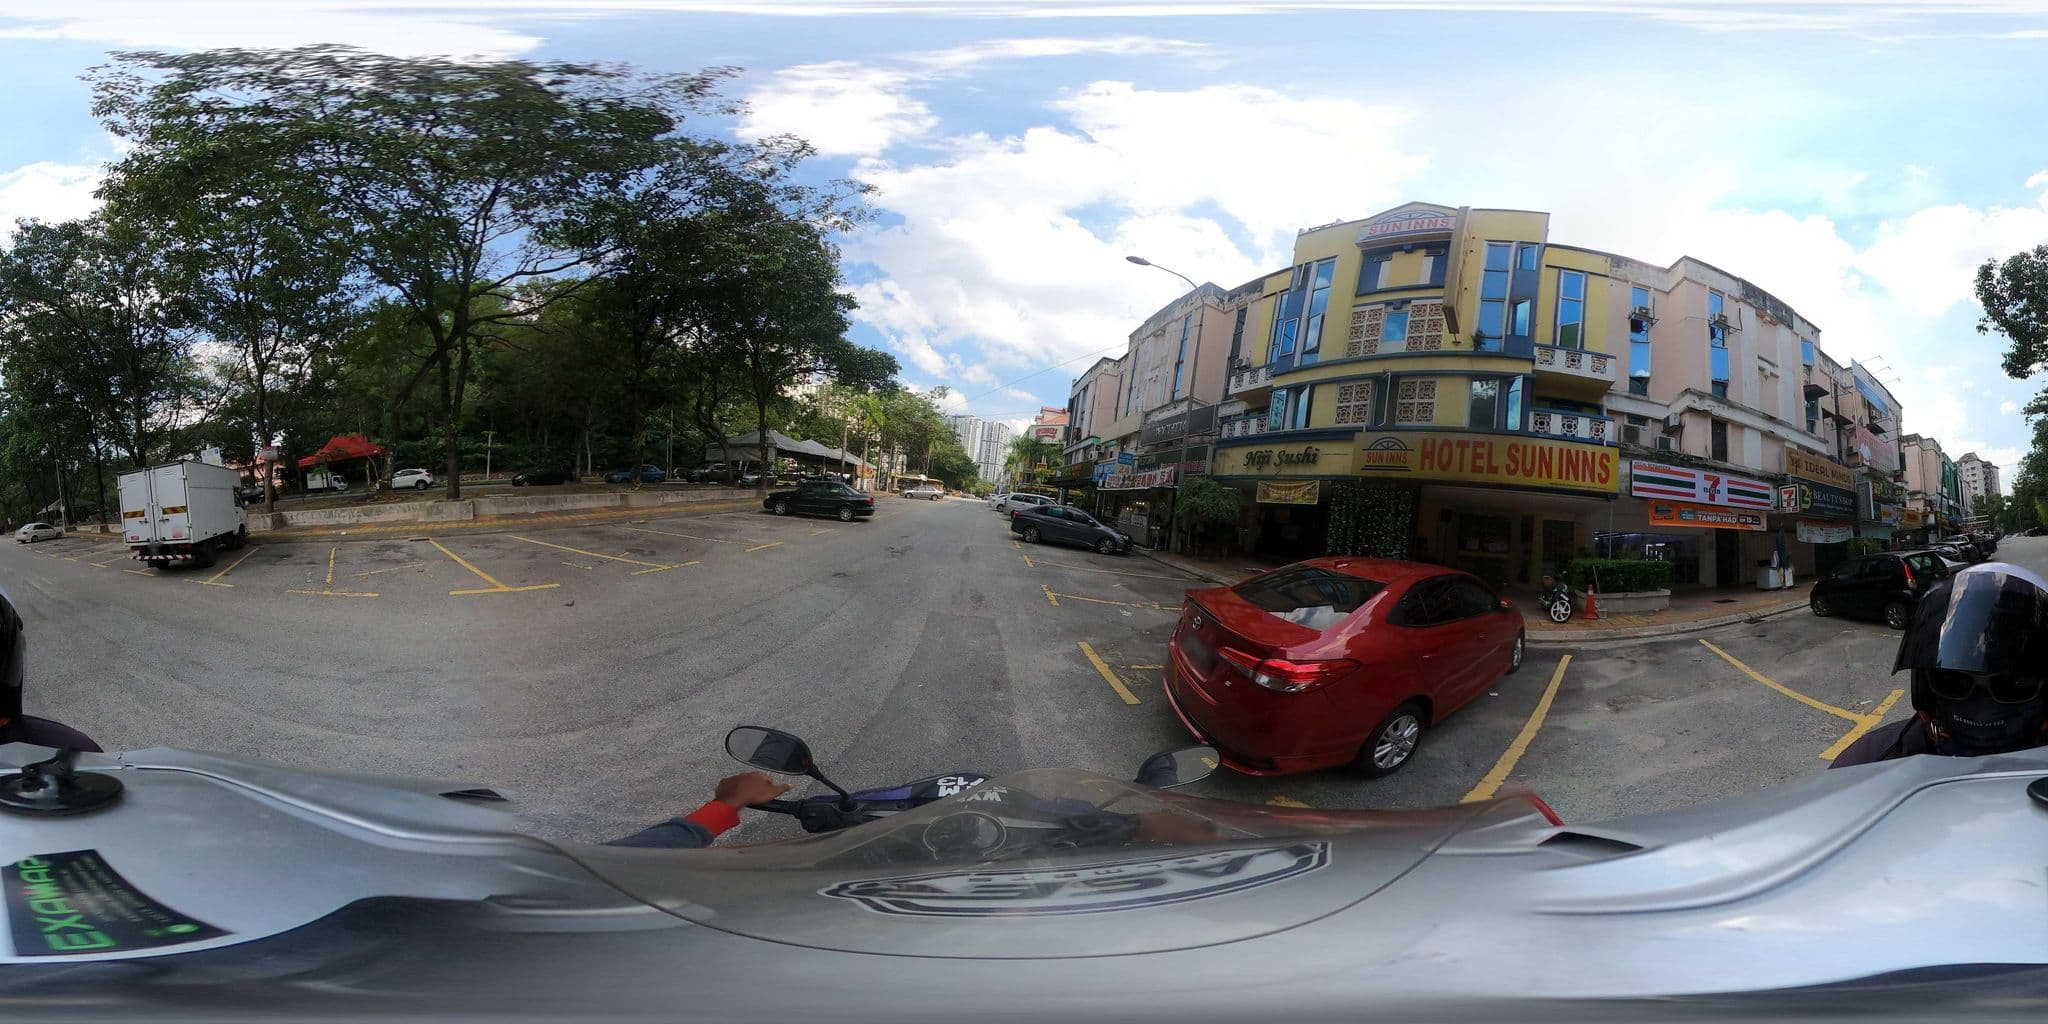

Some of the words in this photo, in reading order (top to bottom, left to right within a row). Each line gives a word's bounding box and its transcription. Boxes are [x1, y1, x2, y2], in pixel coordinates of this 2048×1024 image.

[1369, 223, 1402, 235] SUN
[1408, 218, 1450, 229] INNS
[1274, 446, 1321, 466] Sushi
[1367, 451, 1384, 464] SUN
[1385, 451, 1408, 465] INNS
[1419, 438, 1499, 474] HOTEL
[1506, 443, 1552, 479] SUN
[1558, 448, 1610, 484] INNS
[1805, 461, 1829, 477] IDEAL
[1704, 474, 1720, 502] 7
[1783, 489, 1794, 506] 7
[1698, 515, 1721, 523] TANPA
